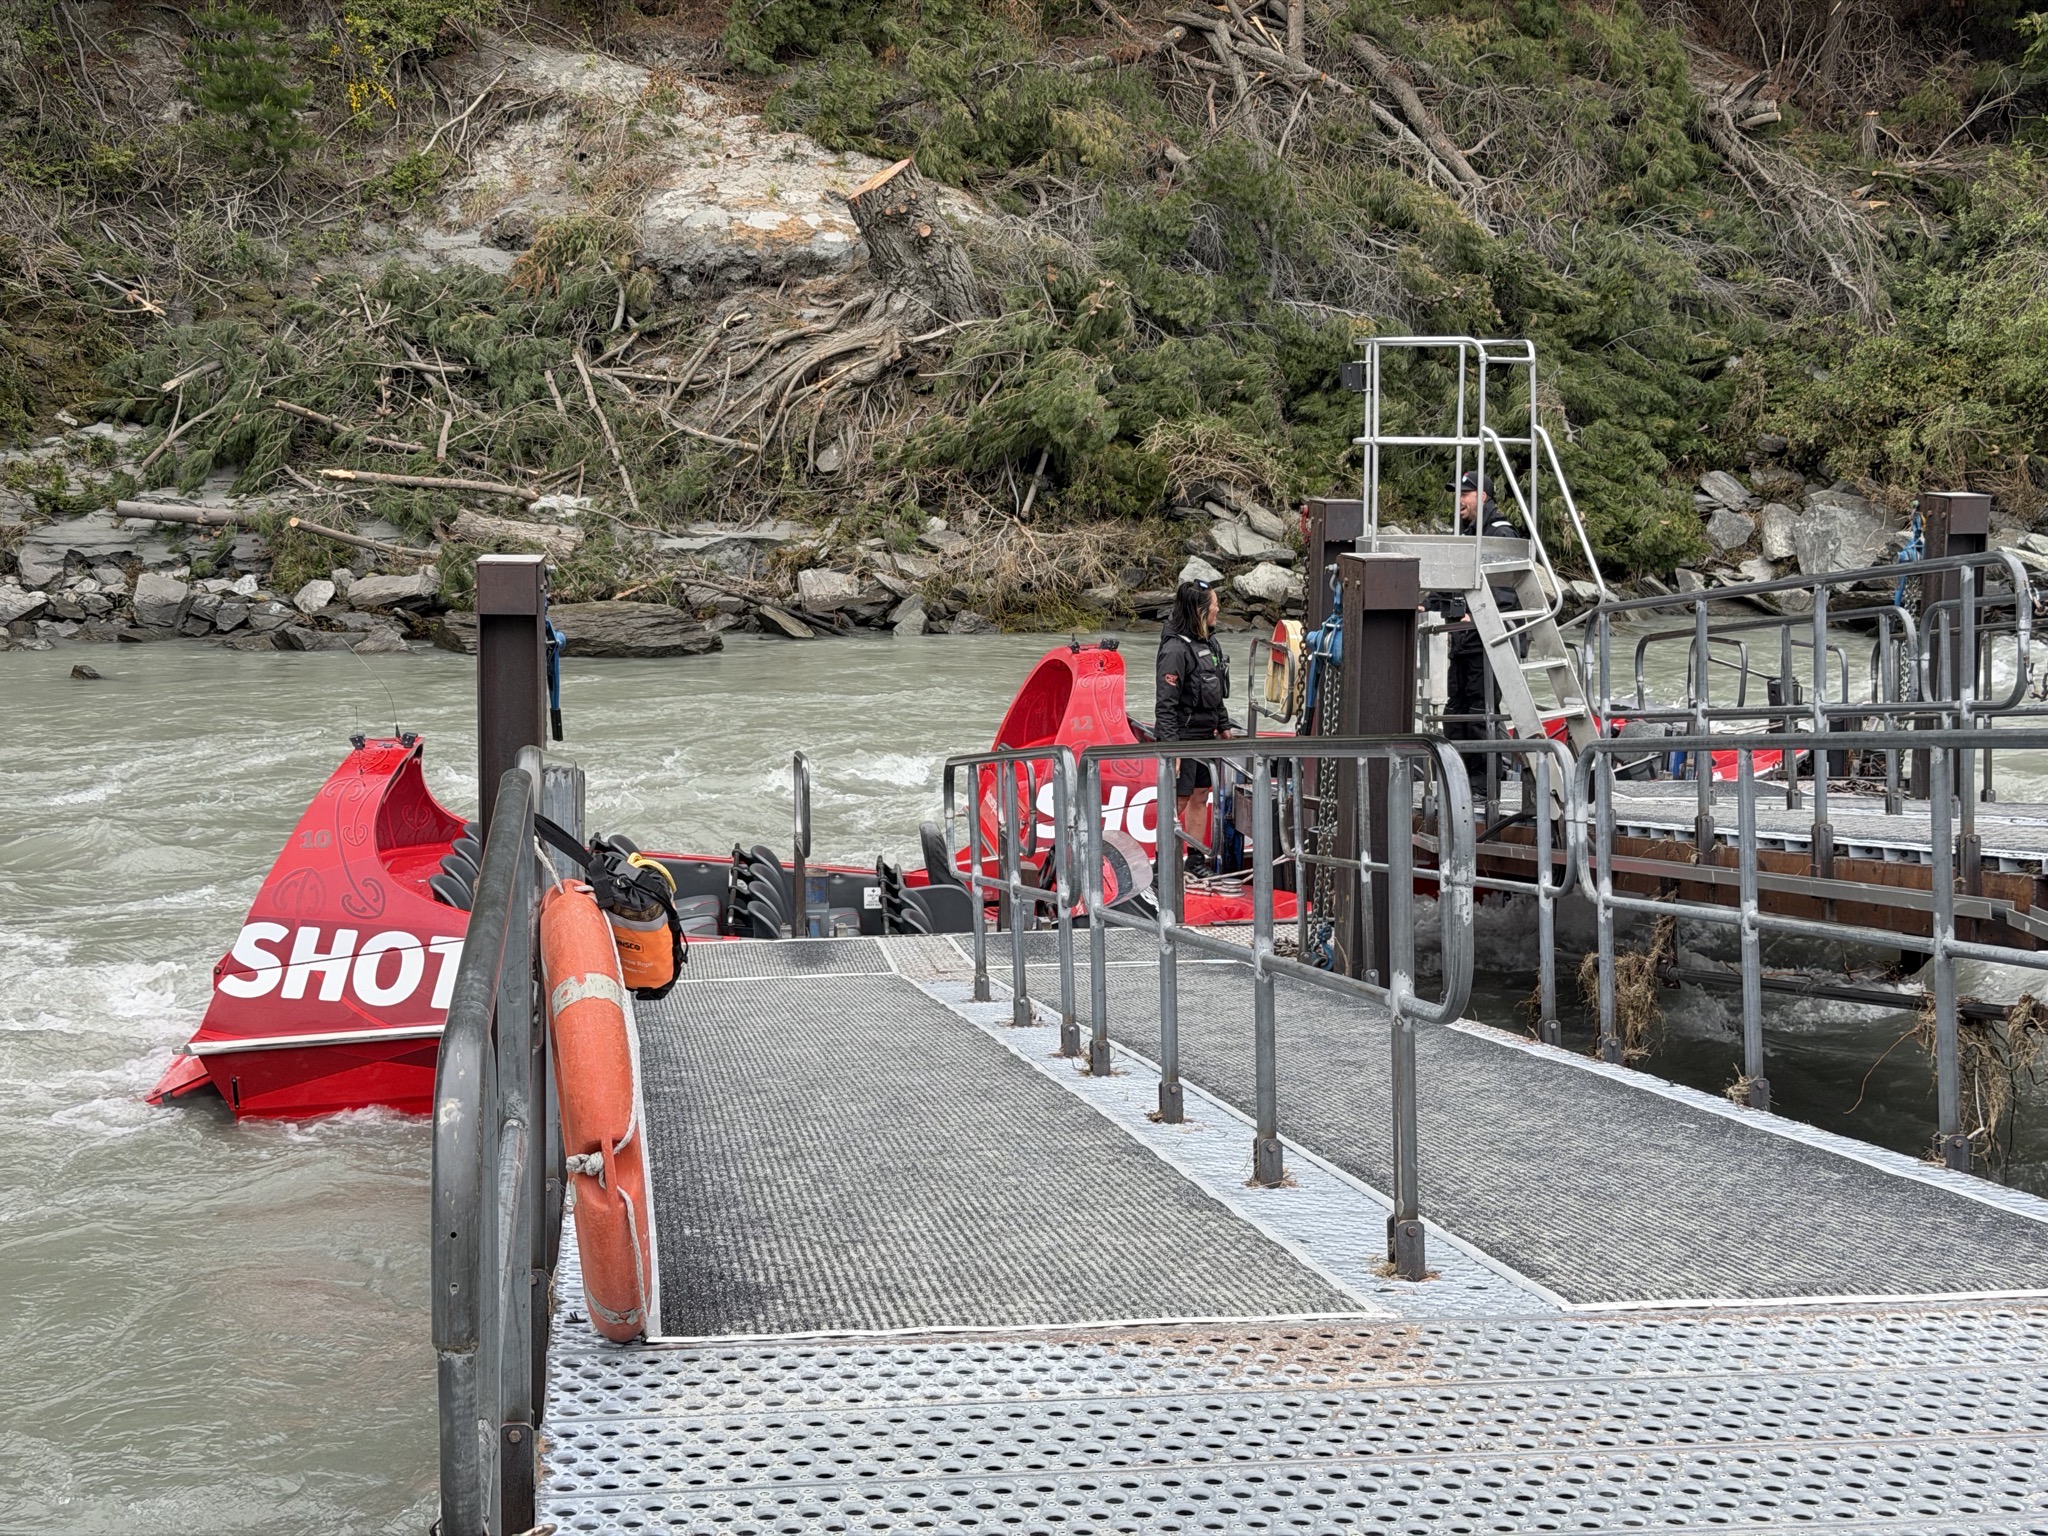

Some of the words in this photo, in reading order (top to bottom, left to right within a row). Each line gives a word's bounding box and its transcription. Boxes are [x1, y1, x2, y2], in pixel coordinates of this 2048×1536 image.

[1071, 716, 1094, 731] 12
[300, 830, 332, 849] 10
[616, 939, 641, 951] NSCO
